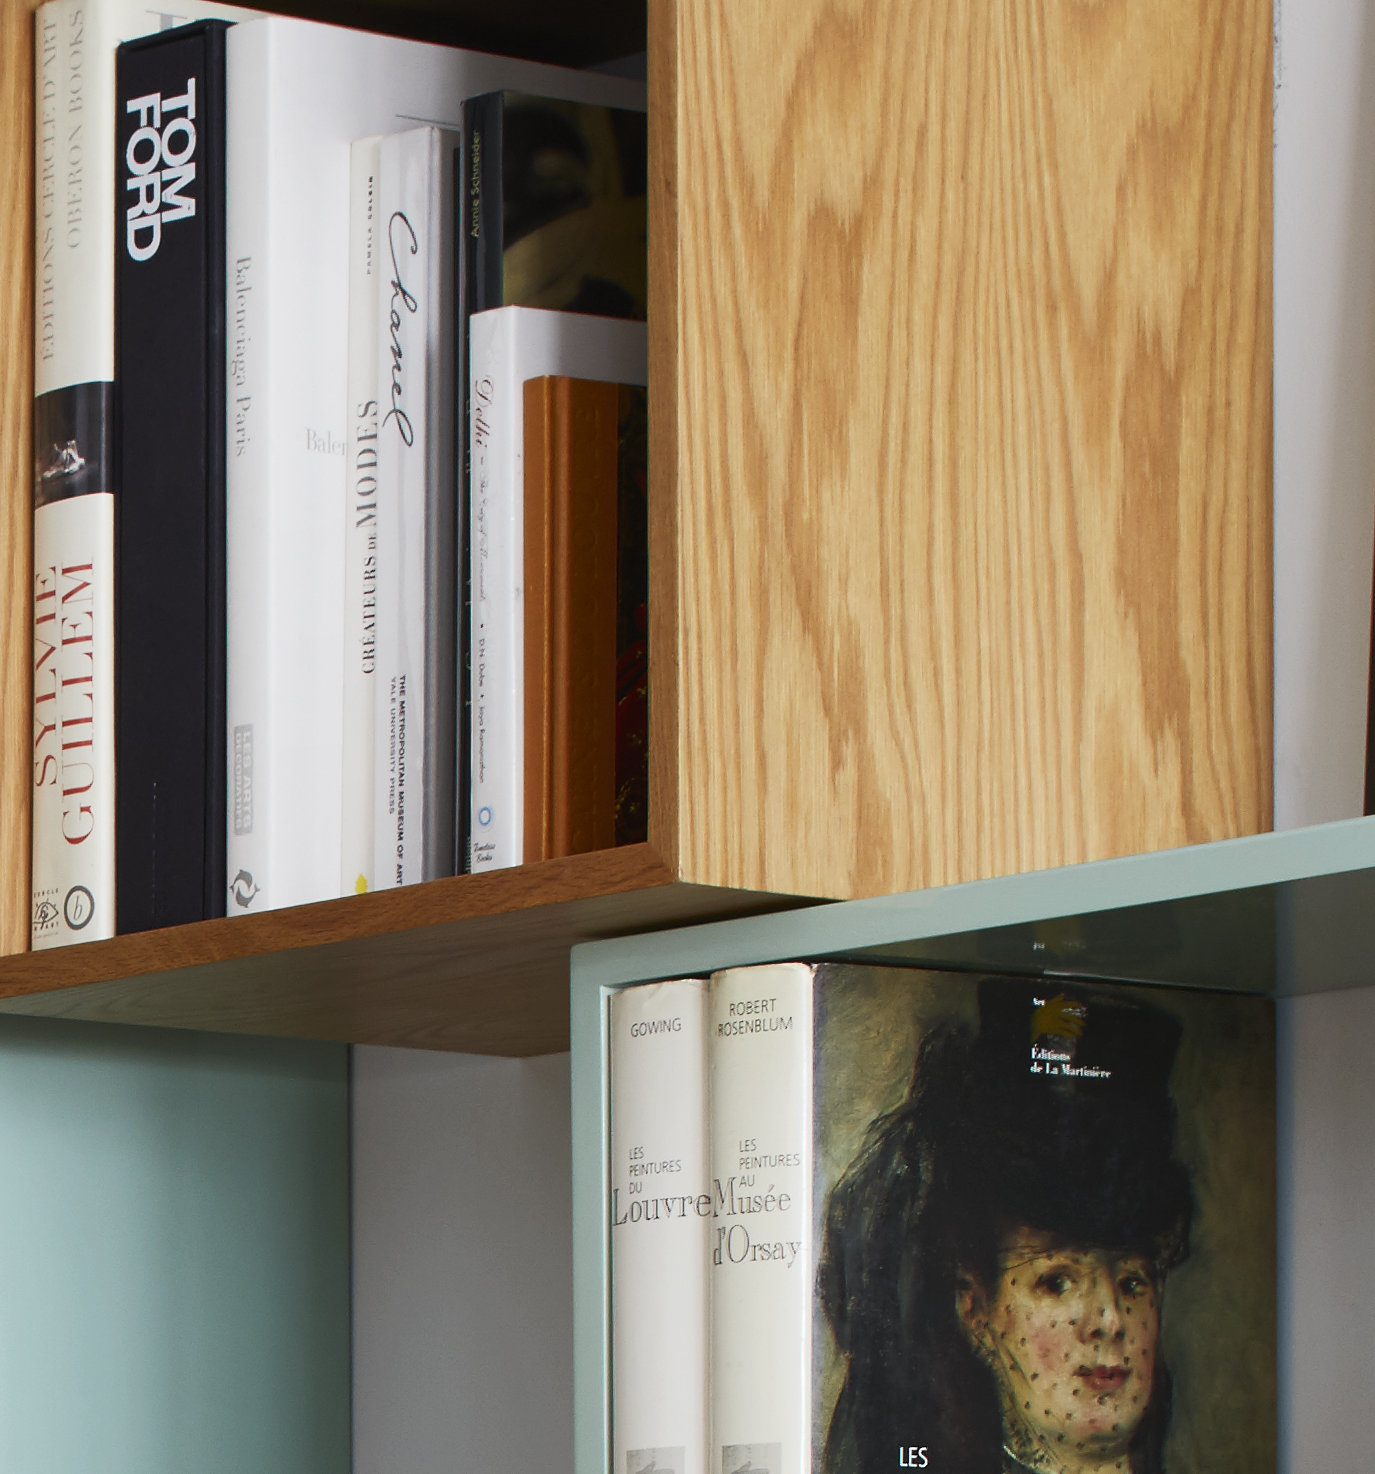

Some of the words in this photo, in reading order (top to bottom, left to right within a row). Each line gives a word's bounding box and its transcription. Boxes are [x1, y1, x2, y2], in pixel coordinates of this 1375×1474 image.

[68, 8, 85, 114] BOOKS
[161, 76, 196, 224] TOM
[471, 130, 480, 196] Schneider
[67, 124, 84, 249] OBERON
[125, 91, 162, 262] FORD
[470, 199, 480, 238] Annie
[232, 256, 253, 387] Balenciaga
[382, 211, 418, 447] Chanel
[236, 395, 252, 458] Paris
[475, 375, 494, 448] Delhi
[355, 400, 378, 529] MODES
[360, 555, 376, 675] CRÉATEURS
[34, 566, 58, 788] SYLVIE
[398, 673, 406, 697] THE
[61, 556, 95, 845] GUILLEM
[398, 700, 406, 787] METROPOLITAN
[397, 791, 405, 842] MUSEUM
[396, 844, 404, 860] OF
[395, 863, 403, 885] ART
[630, 1017, 682, 1038] GOWING
[716, 1016, 794, 1038] ROSENBLUM
[729, 998, 778, 1017] ROBERT
[1045, 1063, 1059, 1075] La
[629, 1146, 645, 1161] LES
[739, 1138, 758, 1153] LES
[739, 1153, 801, 1170] PEINTURES
[629, 1159, 682, 1178] PEINTURES
[629, 1181, 643, 1195] DU
[738, 1174, 756, 1189] AU
[612, 1187, 712, 1227] Louvre
[712, 1176, 792, 1218] Musée
[713, 1224, 803, 1269] d'Orsay
[899, 1446, 929, 1469] LES
